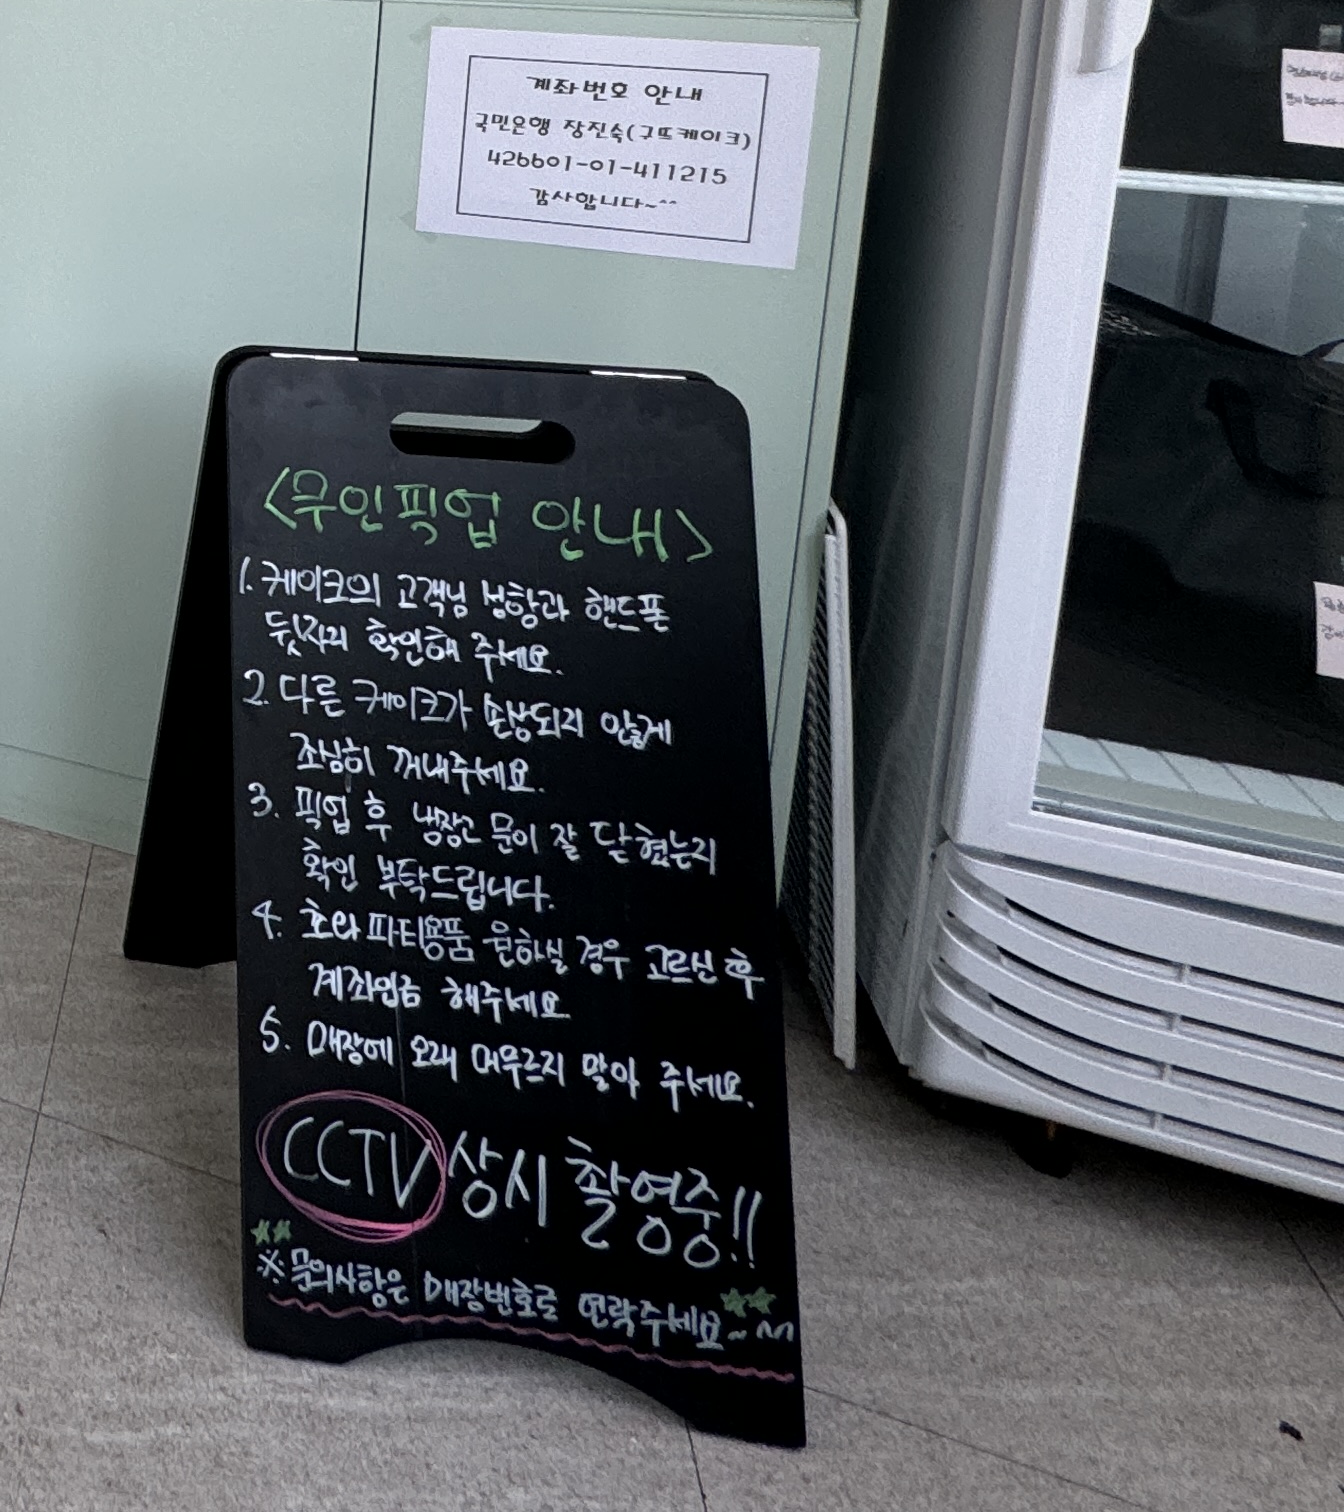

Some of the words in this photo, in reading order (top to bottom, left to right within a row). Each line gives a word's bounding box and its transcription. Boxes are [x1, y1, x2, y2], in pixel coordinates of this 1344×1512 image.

[526, 76, 629, 101] 계좌번호
[644, 84, 703, 106] 안내
[475, 113, 550, 135] 국민은행
[563, 118, 752, 151] 장진숙(구뜨케이크)
[487, 150, 727, 185] 426601-01-411215
[262, 561, 380, 607] 케이크의
[398, 574, 468, 617] 고객님
[585, 588, 670, 632] 핸드폰
[265, 610, 347, 656] 뒷자리
[368, 619, 460, 667] 확인해
[279, 674, 344, 716] 다른
[353, 679, 470, 730] 케이크가
[484, 692, 583, 742] 손상되지
[601, 711, 671, 751] 않게
[290, 732, 373, 776] 조심히
[295, 788, 350, 834] 픽업
[364, 791, 392, 842] 후
[413, 800, 482, 847] 냉장고
[491, 812, 537, 854] 문이
[551, 823, 579, 860] 잘
[303, 837, 356, 887] 확인
[377, 854, 553, 912] 부탁드립니다.
[299, 898, 360, 942] 초와
[367, 910, 474, 962] 파티용품
[483, 920, 566, 973] 원하실
[577, 935, 630, 979] 경우
[646, 944, 717, 986] 고르신
[725, 948, 764, 999] 후
[309, 962, 421, 1010] 계좌입금
[307, 1020, 393, 1067] 매장에
[412, 1035, 456, 1082] 오래
[472, 1043, 565, 1089] 머무르지
[583, 1054, 637, 1097] 말아
[283, 1117, 433, 1208] CCTV
[448, 1131, 547, 1227] 상시
[566, 1136, 761, 1269] 촬영중!!
[425, 1271, 558, 1321] 매장번호로
